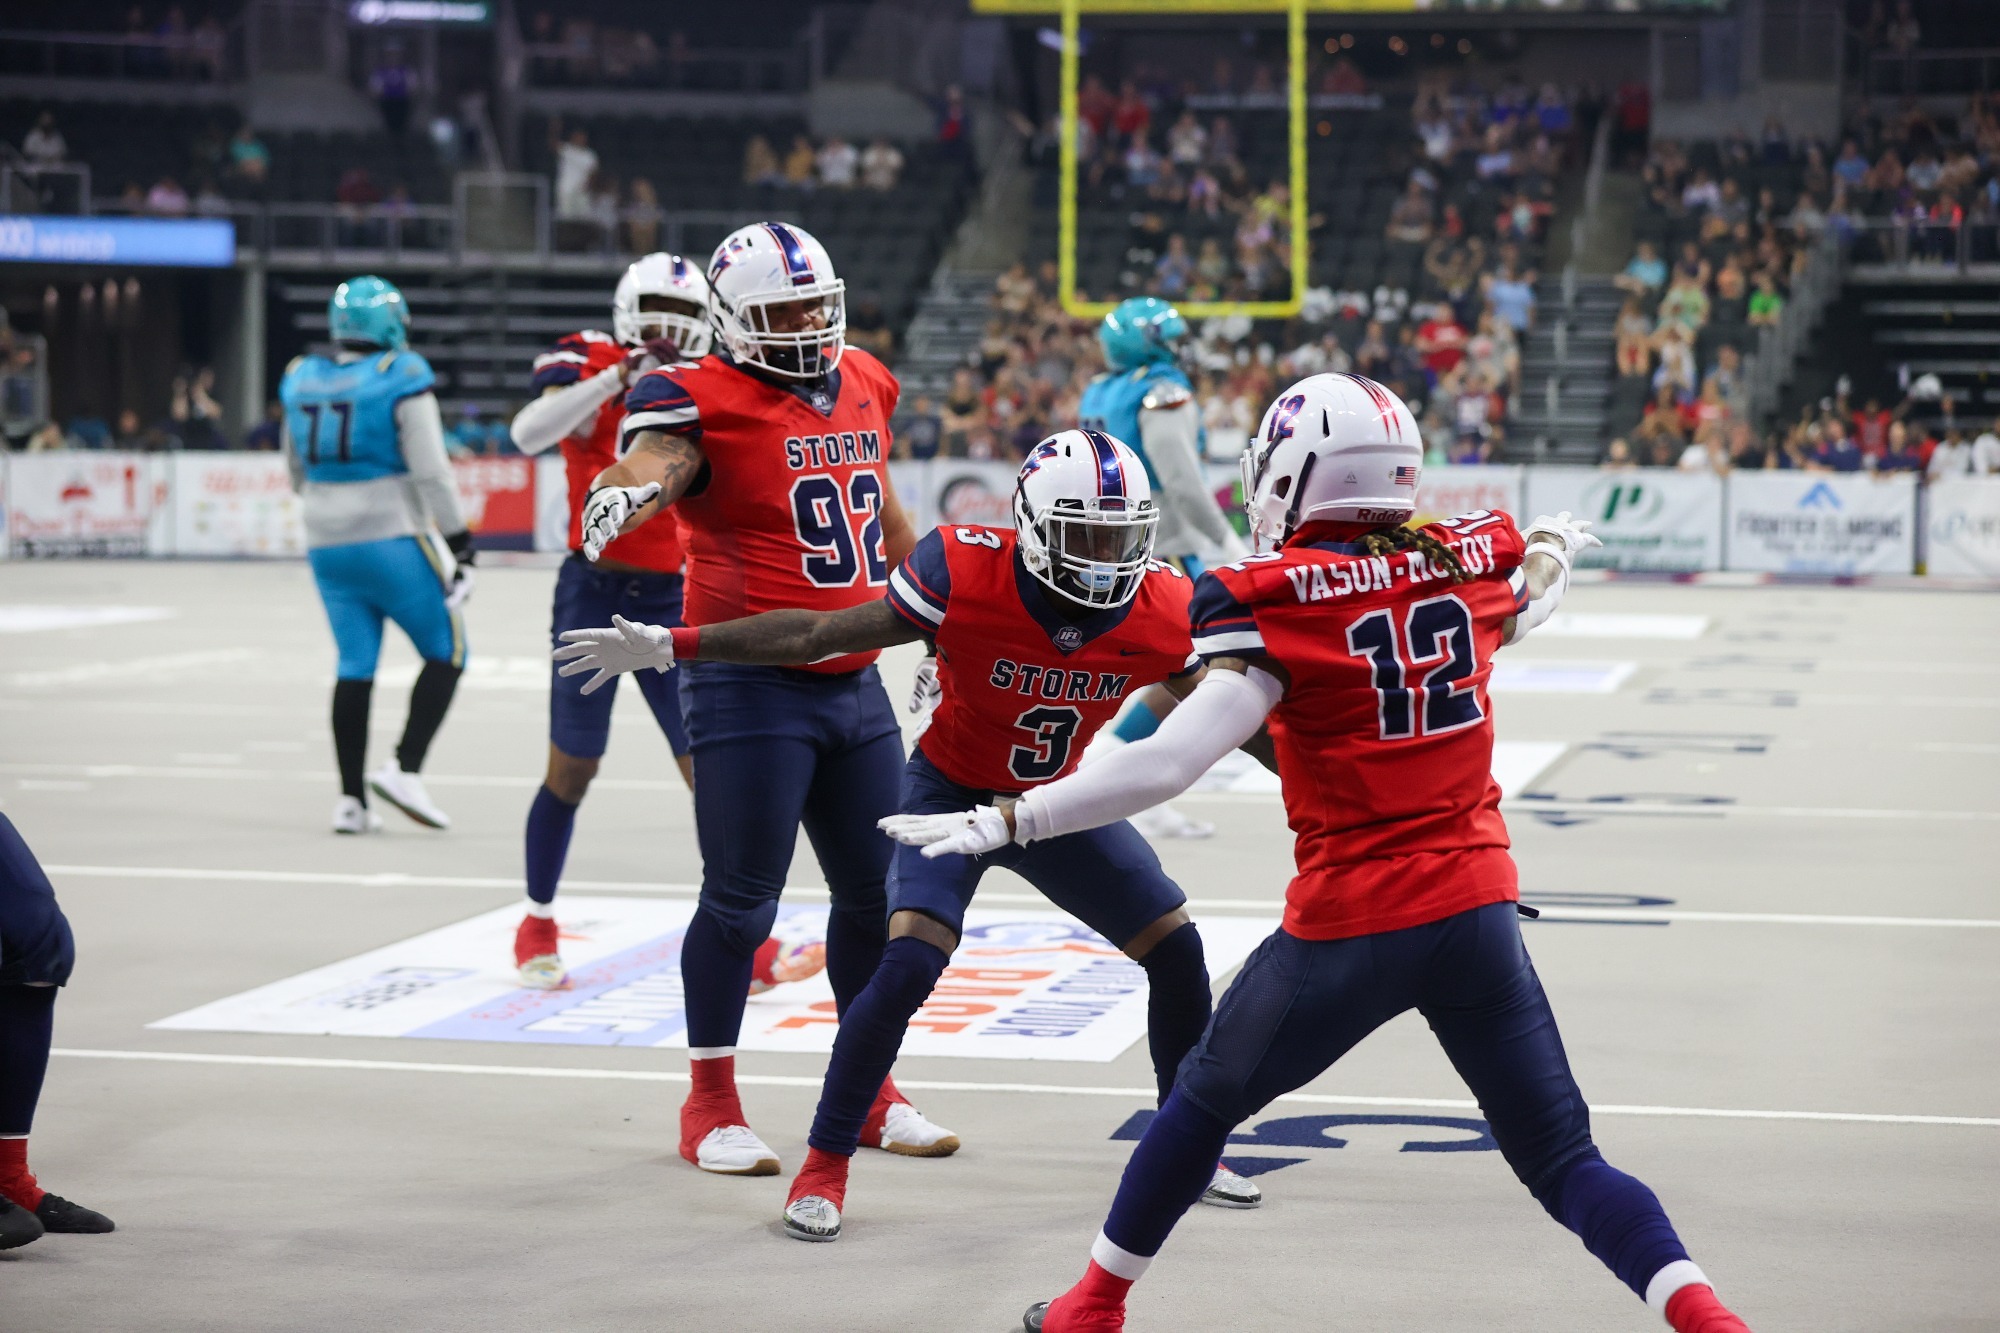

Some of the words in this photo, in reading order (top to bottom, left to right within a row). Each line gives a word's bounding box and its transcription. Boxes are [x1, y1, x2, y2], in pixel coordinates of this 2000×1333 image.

[1267, 394, 1306, 442] 12
[785, 430, 881, 470] STORM
[788, 469, 889, 588] 92
[1356, 508, 1415, 523] Riddell
[954, 527, 1001, 551] 3
[990, 658, 1132, 701] STORM
[1345, 593, 1486, 741] 12
[1007, 703, 1083, 782] 3
